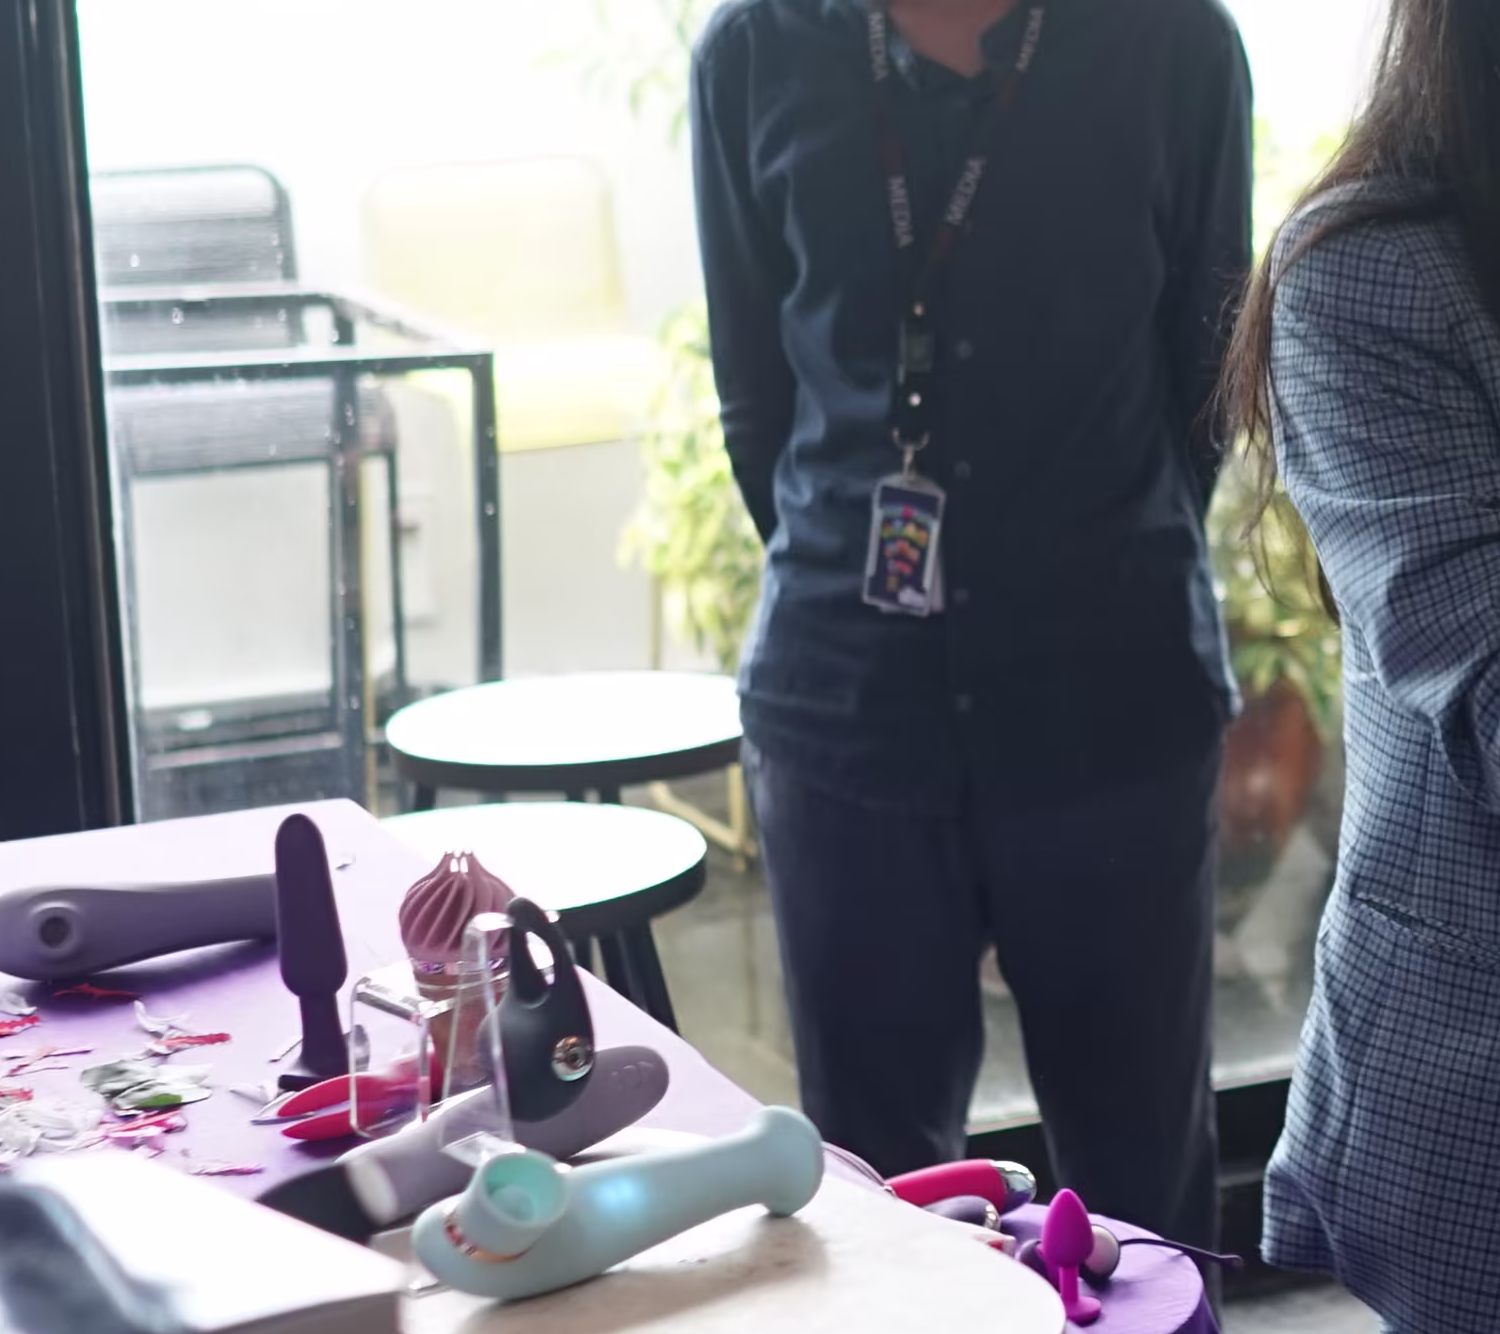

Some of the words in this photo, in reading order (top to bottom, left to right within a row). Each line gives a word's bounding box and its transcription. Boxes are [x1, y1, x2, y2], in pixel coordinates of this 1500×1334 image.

[868, 10, 888, 83] MEDIA
[1016, 6, 1044, 72] MEDIA
[888, 175, 914, 249] MEDIA
[946, 156, 987, 225] MEDIA
